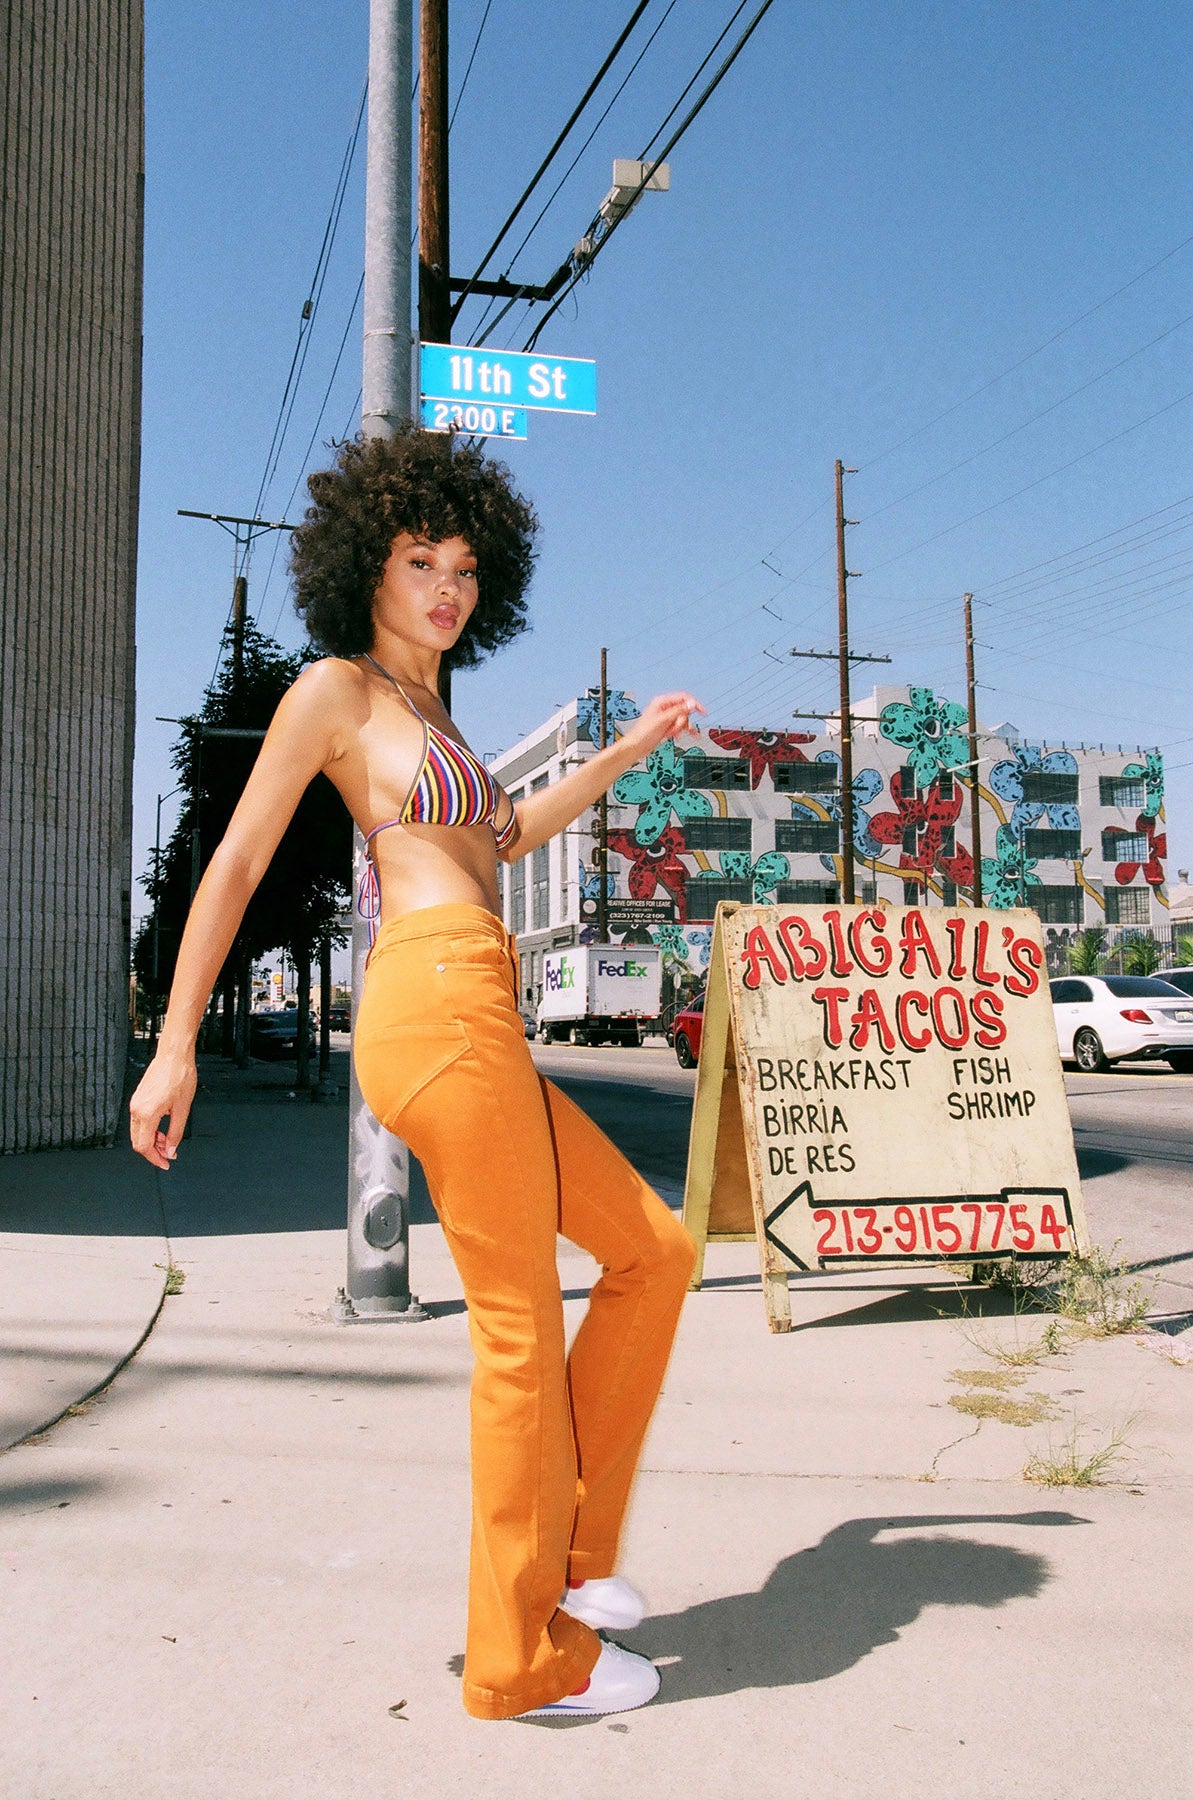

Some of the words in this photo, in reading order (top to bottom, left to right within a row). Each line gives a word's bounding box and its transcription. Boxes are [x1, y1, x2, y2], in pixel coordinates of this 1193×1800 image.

[450, 355, 511, 395] 11th
[528, 363, 567, 400] St
[434, 403, 496, 432] 2300
[502, 410, 515, 434] E
[607, 899, 626, 907] REATIVE
[627, 900, 646, 908] OFFICES
[646, 900, 656, 908] FOR
[598, 960, 648, 977] FedEx
[741, 909, 1044, 998] ABIGAIL'S
[546, 956, 575, 991] FedEx
[811, 985, 1008, 1055] TACOS
[757, 1059, 911, 1092] BREAKFAST
[954, 1057, 1011, 1085] FISH
[947, 1090, 1036, 1121] SHRIMP
[768, 1146, 798, 1176] DE
[807, 1144, 857, 1174] RES
[813, 1203, 1067, 1255] 213-9157754
